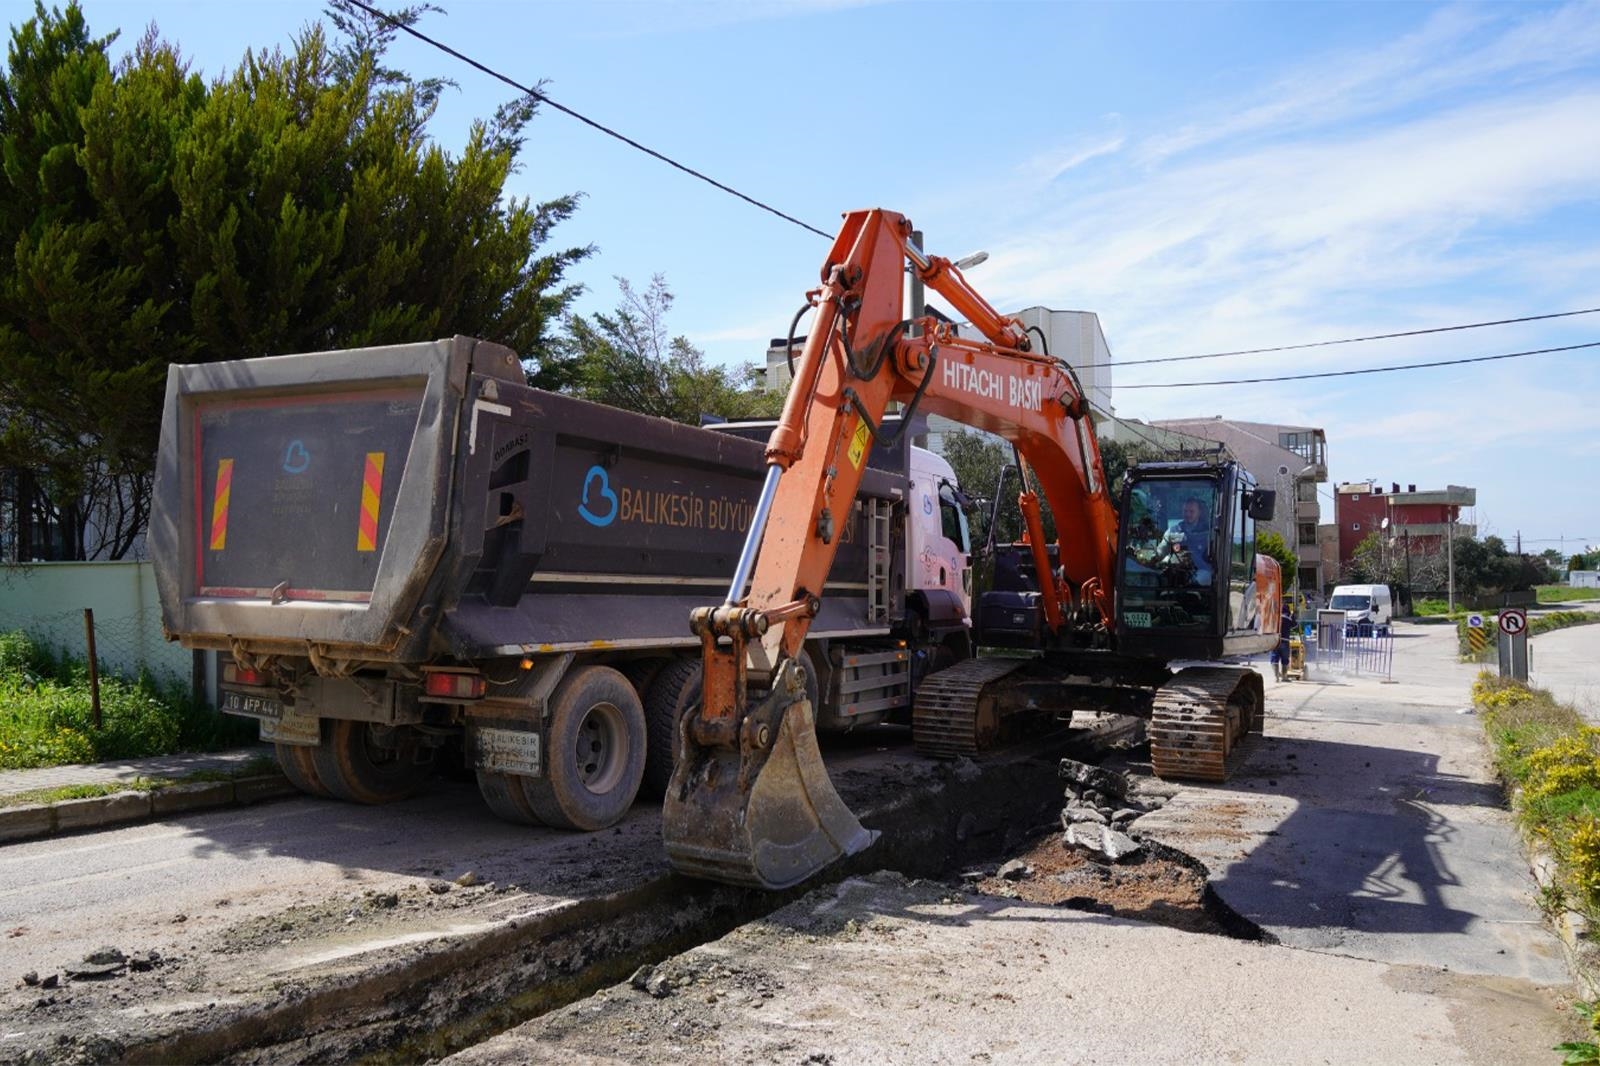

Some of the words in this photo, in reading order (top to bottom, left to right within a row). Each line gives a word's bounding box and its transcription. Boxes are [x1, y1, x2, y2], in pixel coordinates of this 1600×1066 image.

[943, 359, 1003, 401] HITACHI
[620, 487, 704, 528] BALIKESİR
[230, 695, 239, 709] 10
[243, 698, 261, 713] AFP
